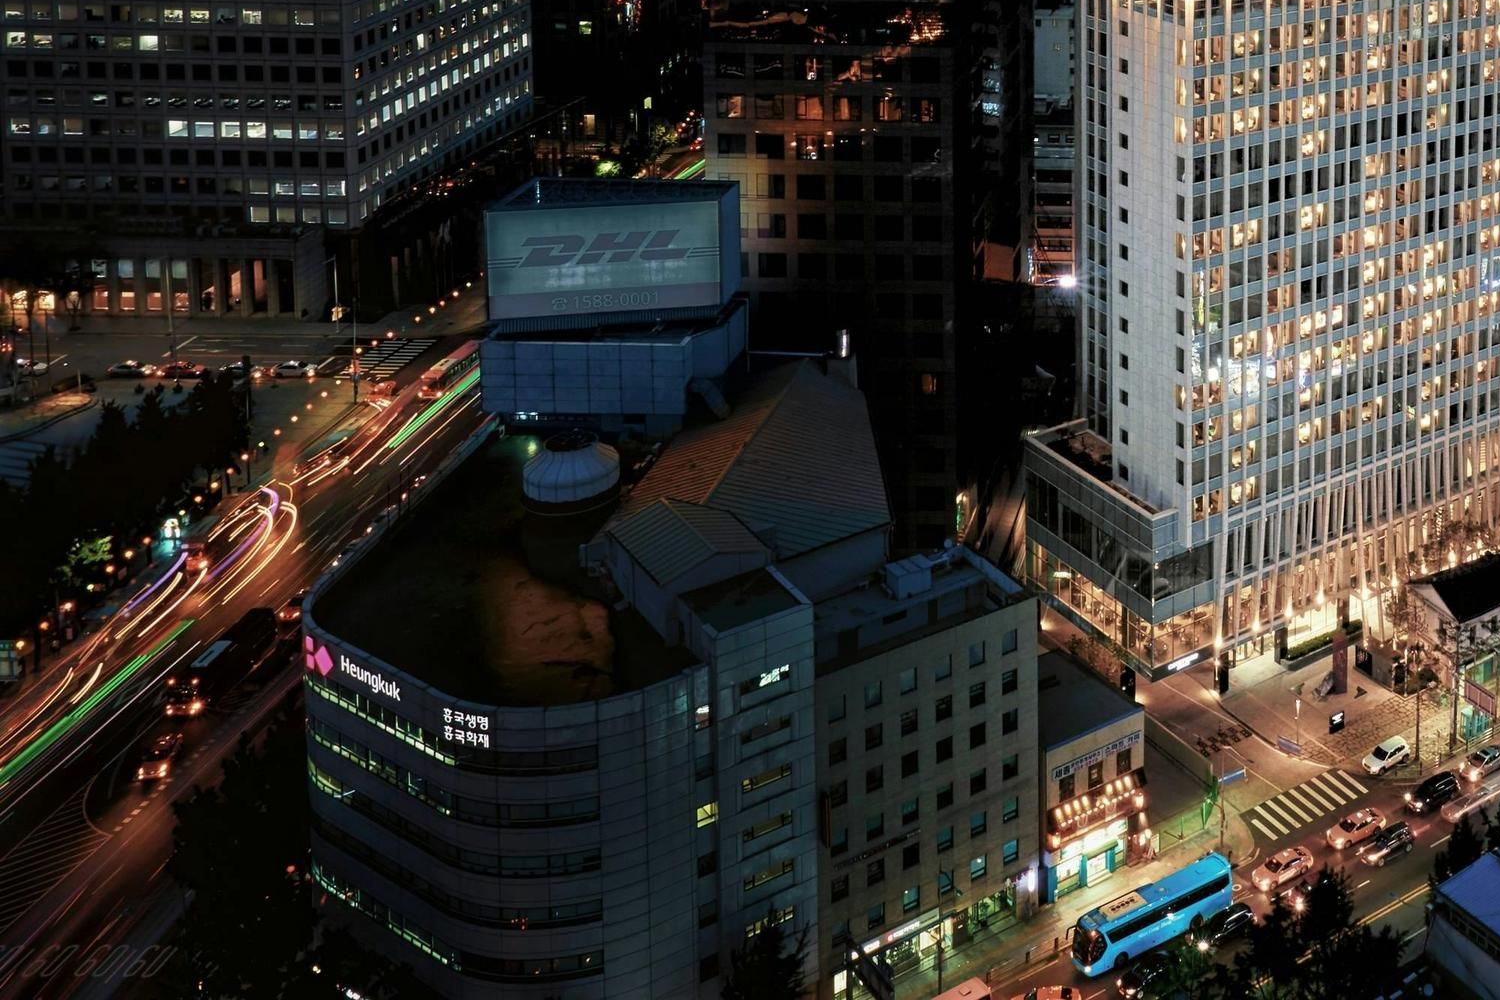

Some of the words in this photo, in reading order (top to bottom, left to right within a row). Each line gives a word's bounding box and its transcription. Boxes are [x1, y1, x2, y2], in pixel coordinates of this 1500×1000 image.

[519, 229, 690, 268] DHL
[573, 290, 660, 310] 1588-0001
[340, 654, 401, 702] Heungkuk
[442, 707, 490, 732] 흥국생명
[443, 725, 491, 749] 흥국화재
